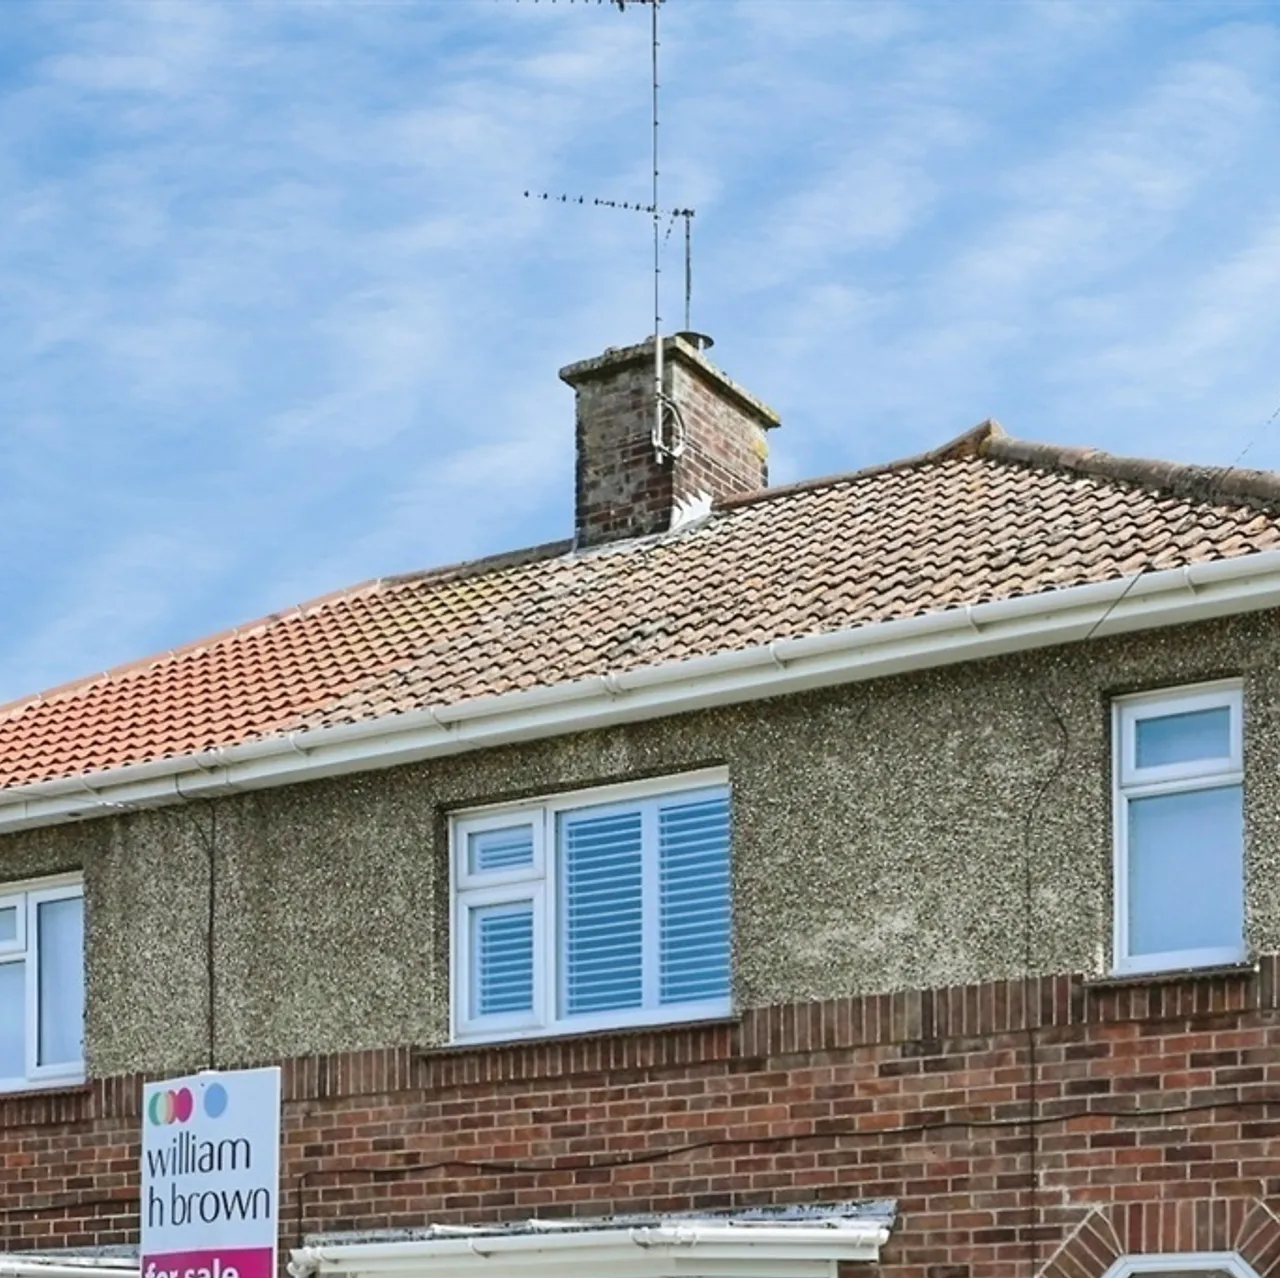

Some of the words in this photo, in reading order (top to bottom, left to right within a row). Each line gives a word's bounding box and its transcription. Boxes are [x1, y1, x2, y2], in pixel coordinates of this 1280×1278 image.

[147, 1131, 251, 1178] william
[148, 1185, 164, 1227] h
[171, 1182, 270, 1226] brown
